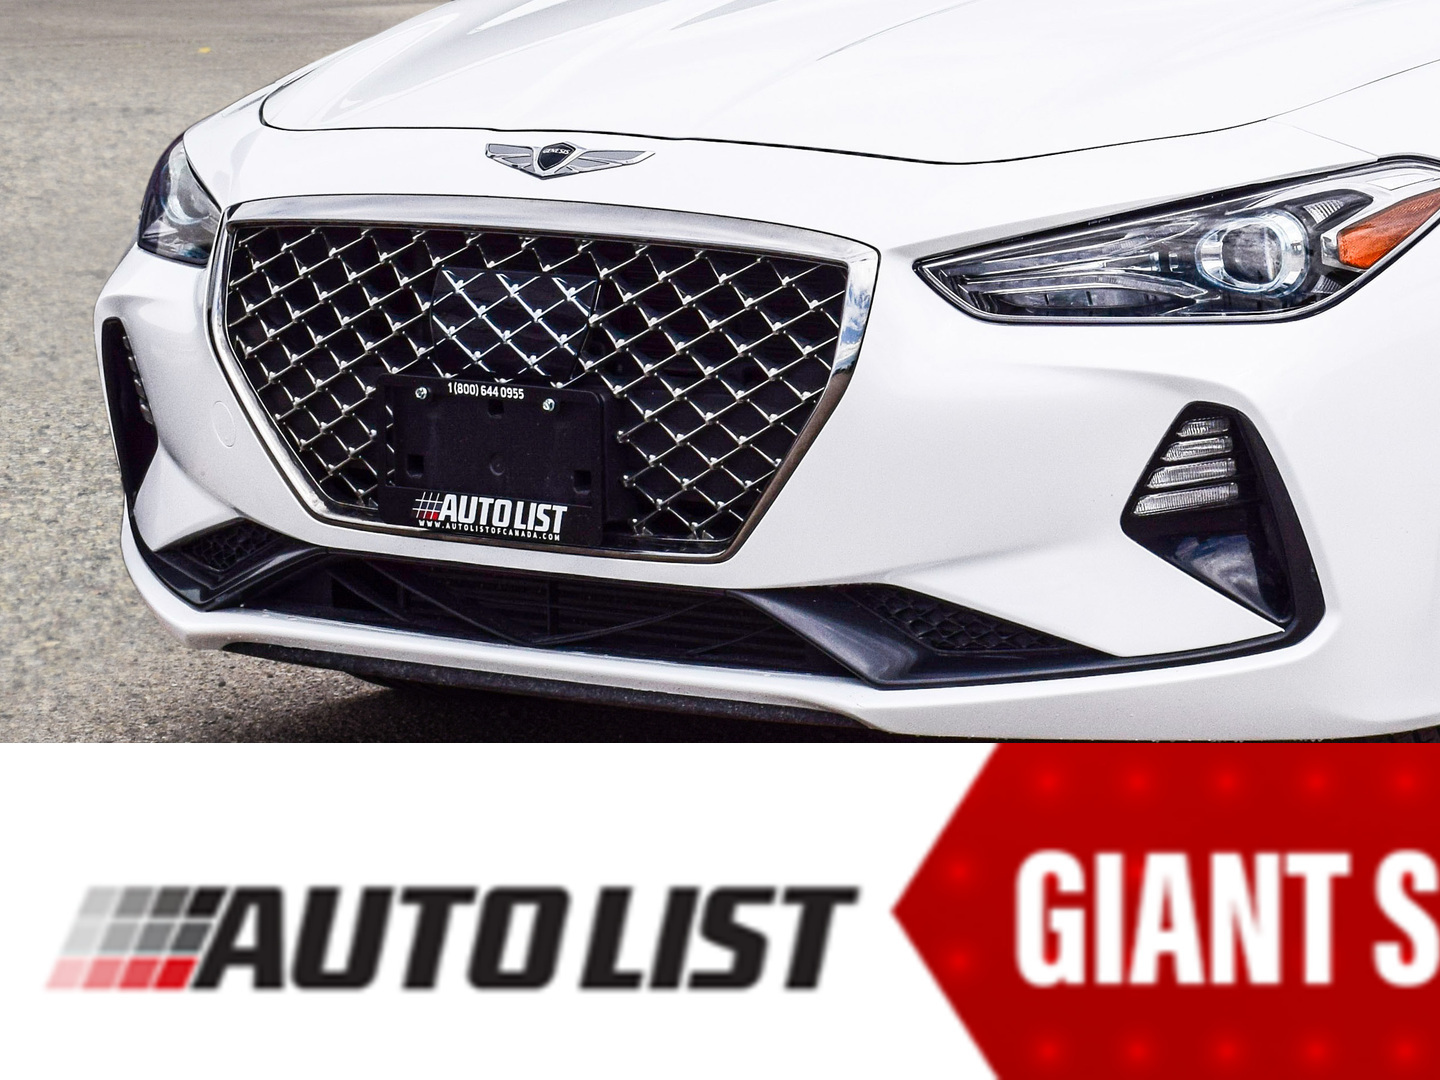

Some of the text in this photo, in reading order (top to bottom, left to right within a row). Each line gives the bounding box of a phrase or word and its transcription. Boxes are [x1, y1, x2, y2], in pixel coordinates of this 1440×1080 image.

[480, 385, 499, 397] 644
[500, 387, 525, 400] 0955
[438, 493, 568, 534] AUTO LIST
[418, 519, 561, 542] WWW.AUTOLISTOFCANADA.COM
